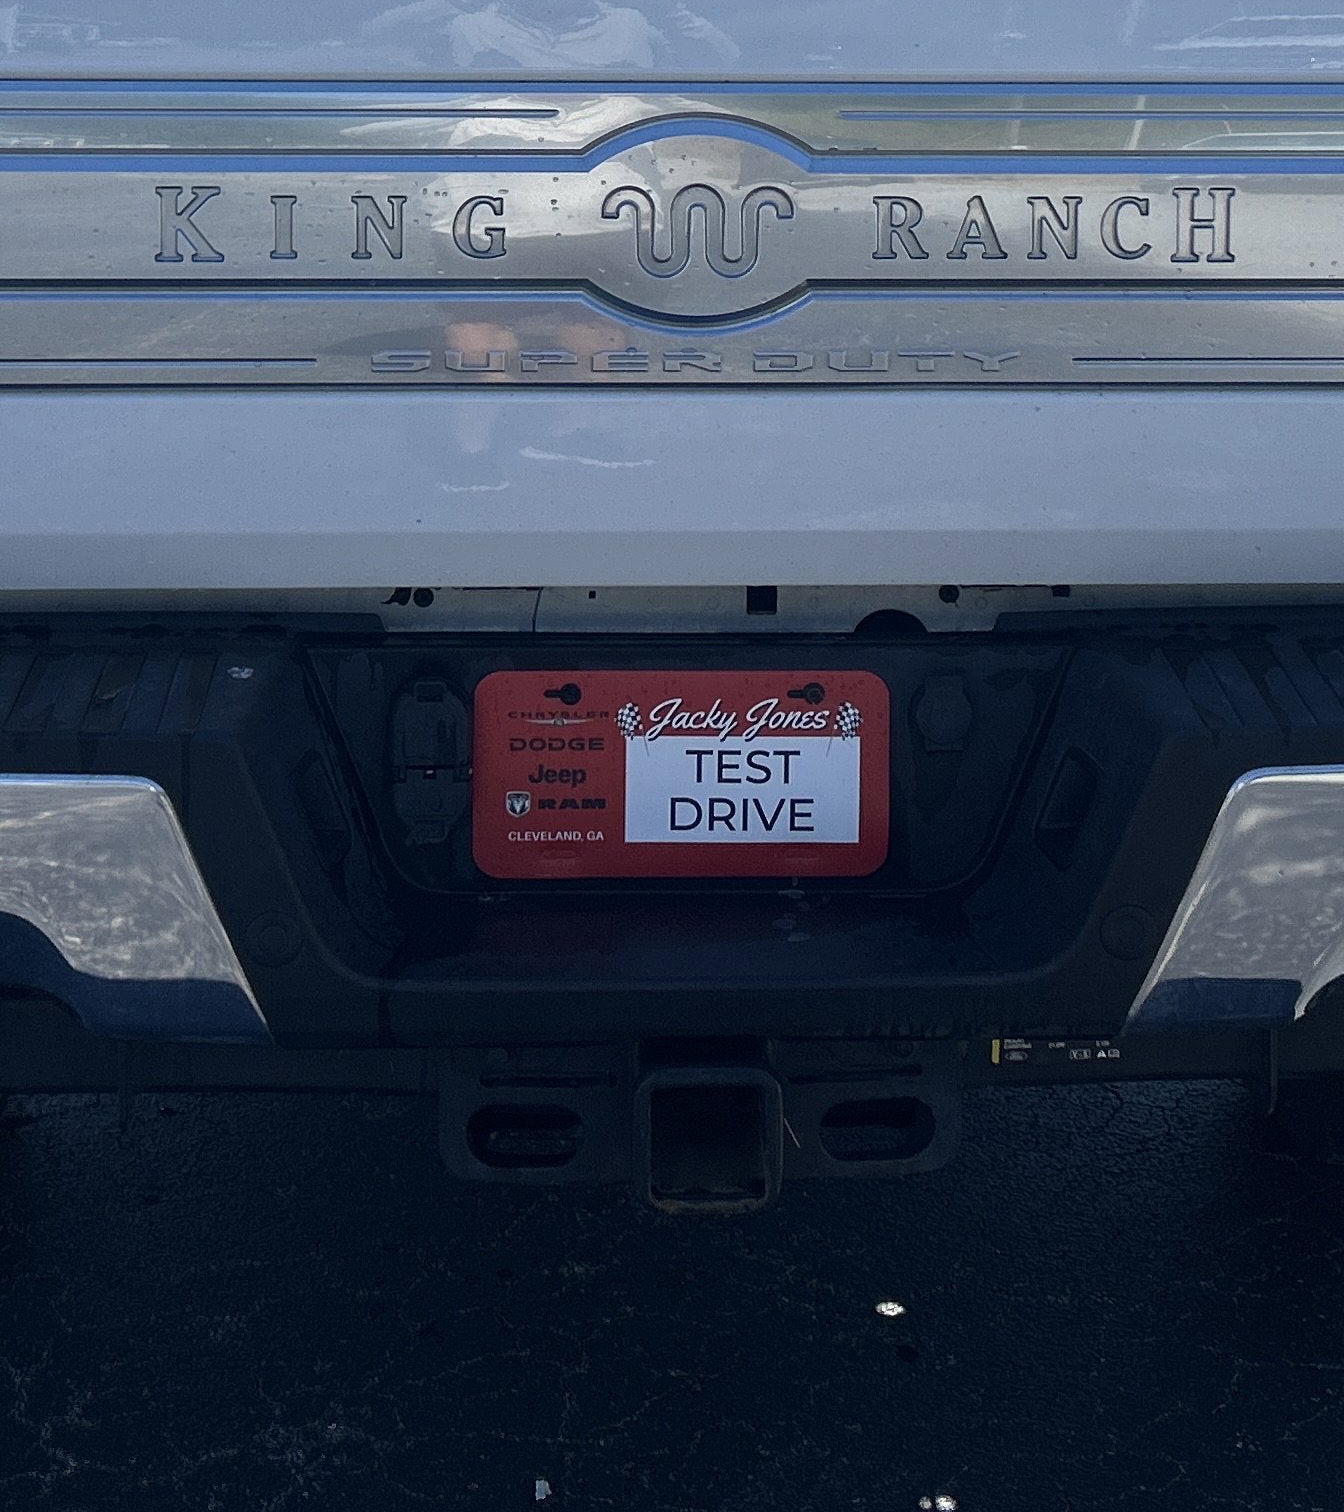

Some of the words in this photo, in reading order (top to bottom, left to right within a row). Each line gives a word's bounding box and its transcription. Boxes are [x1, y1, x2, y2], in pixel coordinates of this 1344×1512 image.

[155, 186, 507, 262] KING
[872, 187, 1236, 263] RANCH
[370, 349, 722, 373] SUPER
[753, 350, 1021, 373] DUTY
[508, 710, 610, 720] CHRYSLER
[645, 697, 738, 742] Jacky
[742, 697, 830, 742] Jones
[509, 737, 605, 752] DODGE
[527, 763, 587, 788] Jeep
[685, 749, 801, 785] TEST
[537, 798, 607, 810] RAM
[669, 796, 815, 832] DRIVE
[507, 830, 584, 843] CLEVELAND,
[586, 830, 604, 842] GA
